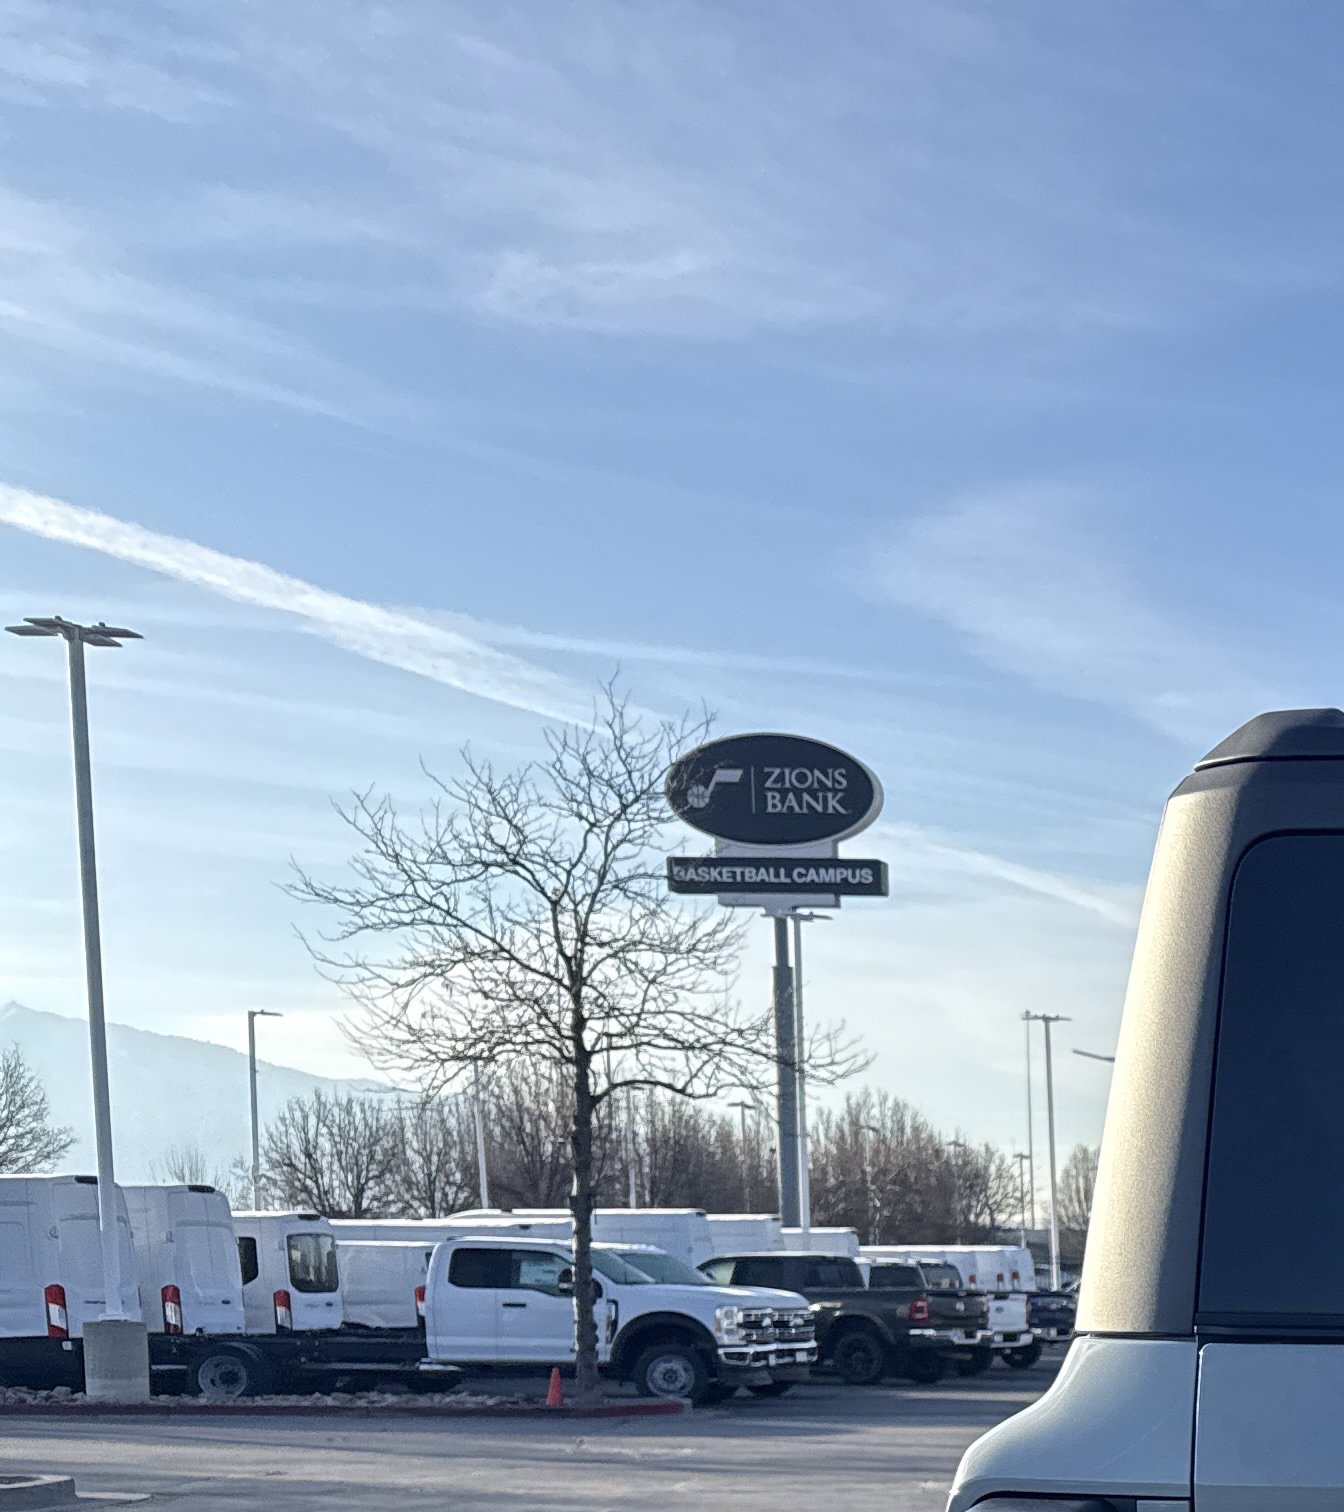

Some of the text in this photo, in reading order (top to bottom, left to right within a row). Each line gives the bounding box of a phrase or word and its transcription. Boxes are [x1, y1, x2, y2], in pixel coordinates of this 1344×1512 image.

[763, 766, 848, 789] ZIONS
[765, 791, 848, 815] BANK
[672, 865, 873, 884] BASKETBALL CAMPUS
